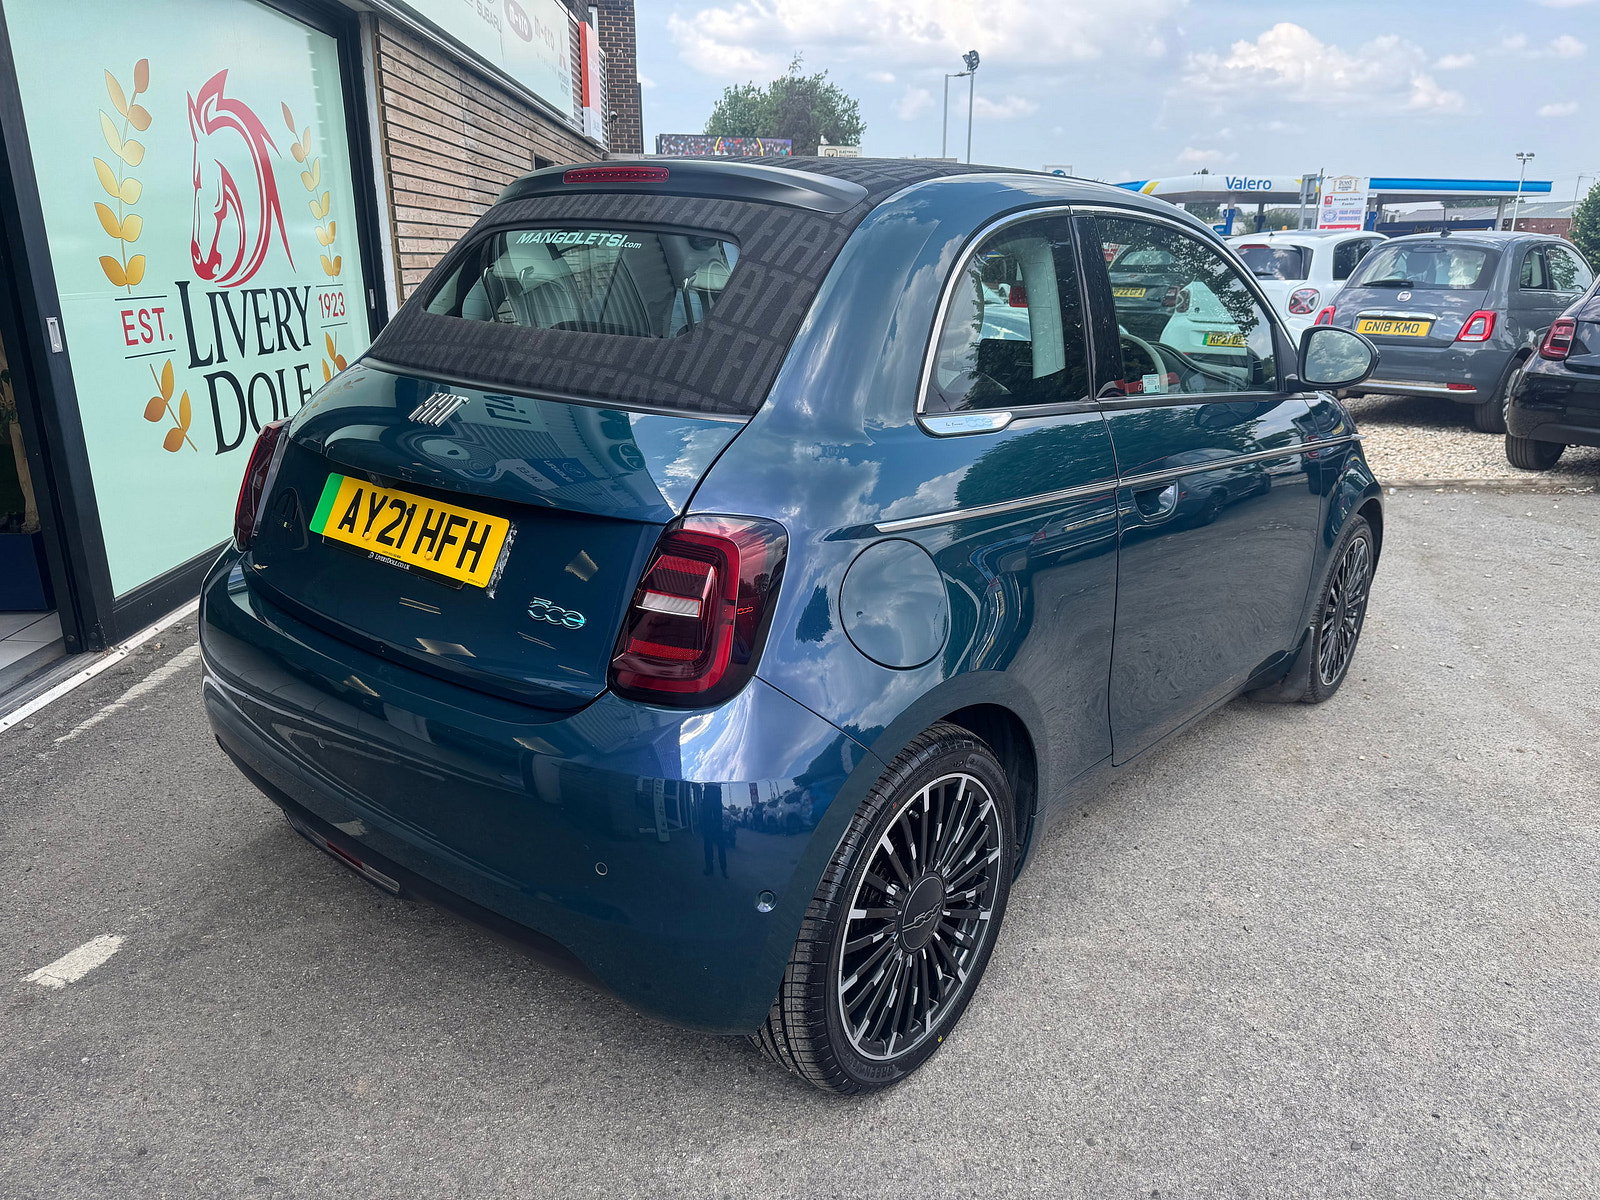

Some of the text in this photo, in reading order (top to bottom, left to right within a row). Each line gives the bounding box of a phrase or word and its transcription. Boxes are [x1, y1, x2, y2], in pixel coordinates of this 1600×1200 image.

[1225, 176, 1272, 190] Valero
[318, 291, 346, 319] 1923
[120, 307, 174, 346] EST.
[174, 280, 312, 370] LIVERY
[1364, 321, 1420, 334] GN18 KMO
[337, 487, 493, 575] AY21 HFH
